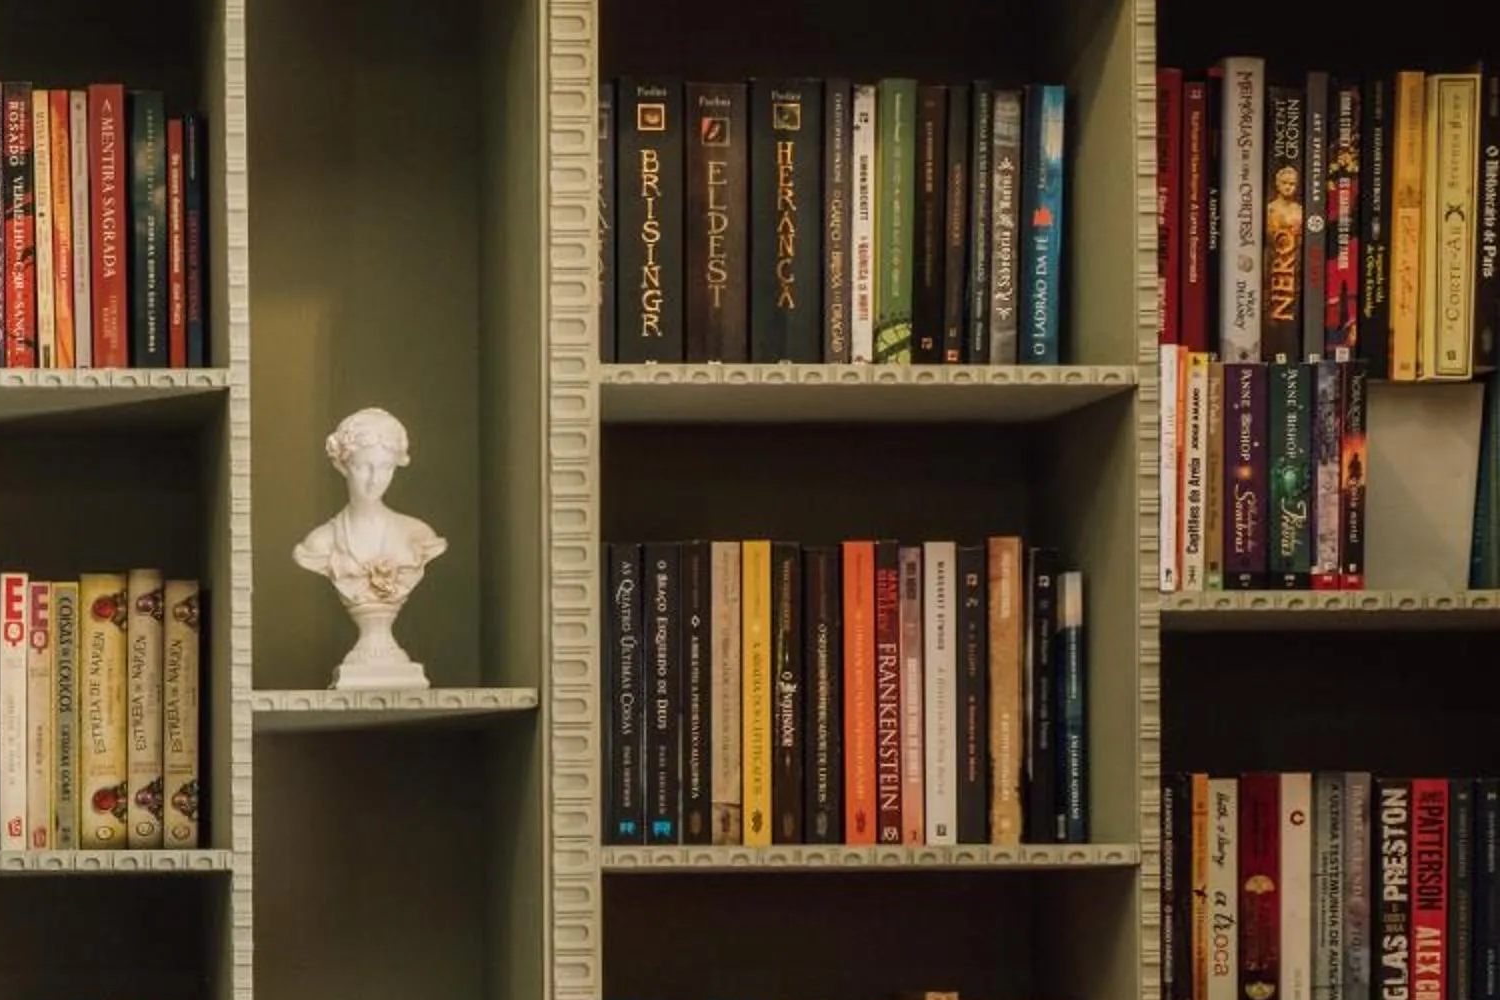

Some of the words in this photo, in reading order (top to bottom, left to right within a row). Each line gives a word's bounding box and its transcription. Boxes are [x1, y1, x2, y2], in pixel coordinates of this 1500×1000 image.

[8, 102, 19, 167] ROSADO
[1237, 70, 1256, 147] MEMÓRIAS
[1275, 100, 1286, 158] VINCENT
[1286, 98, 1300, 159] CRONIN
[100, 117, 116, 192] MENTIRA
[101, 196, 117, 278] SAGRADA
[640, 149, 663, 337] BRISINGR
[707, 161, 729, 308] ELDEST
[1033, 235, 1048, 251] FÉ
[1034, 255, 1048, 275] DA
[1271, 228, 1295, 321] NERO
[1033, 280, 1048, 338] LADRÃO
[1033, 343, 1046, 355] O
[1186, 457, 1201, 487] Areia
[58, 596, 73, 645] COISAS
[616, 578, 634, 633] QUATRO
[58, 660, 73, 714] LOUCOS
[621, 635, 637, 690] ÚLTIMAS
[656, 699, 669, 730] DEUS
[878, 642, 900, 812] FRANKENSTEIN
[1382, 788, 1409, 901] PRESTON
[1416, 804, 1445, 911] PATTERSON
[1328, 843, 1340, 927] TESTEMUNHA
[1212, 913, 1237, 977] troca
[1329, 930, 1340, 945] DE
[1416, 925, 1442, 974] ALEX
